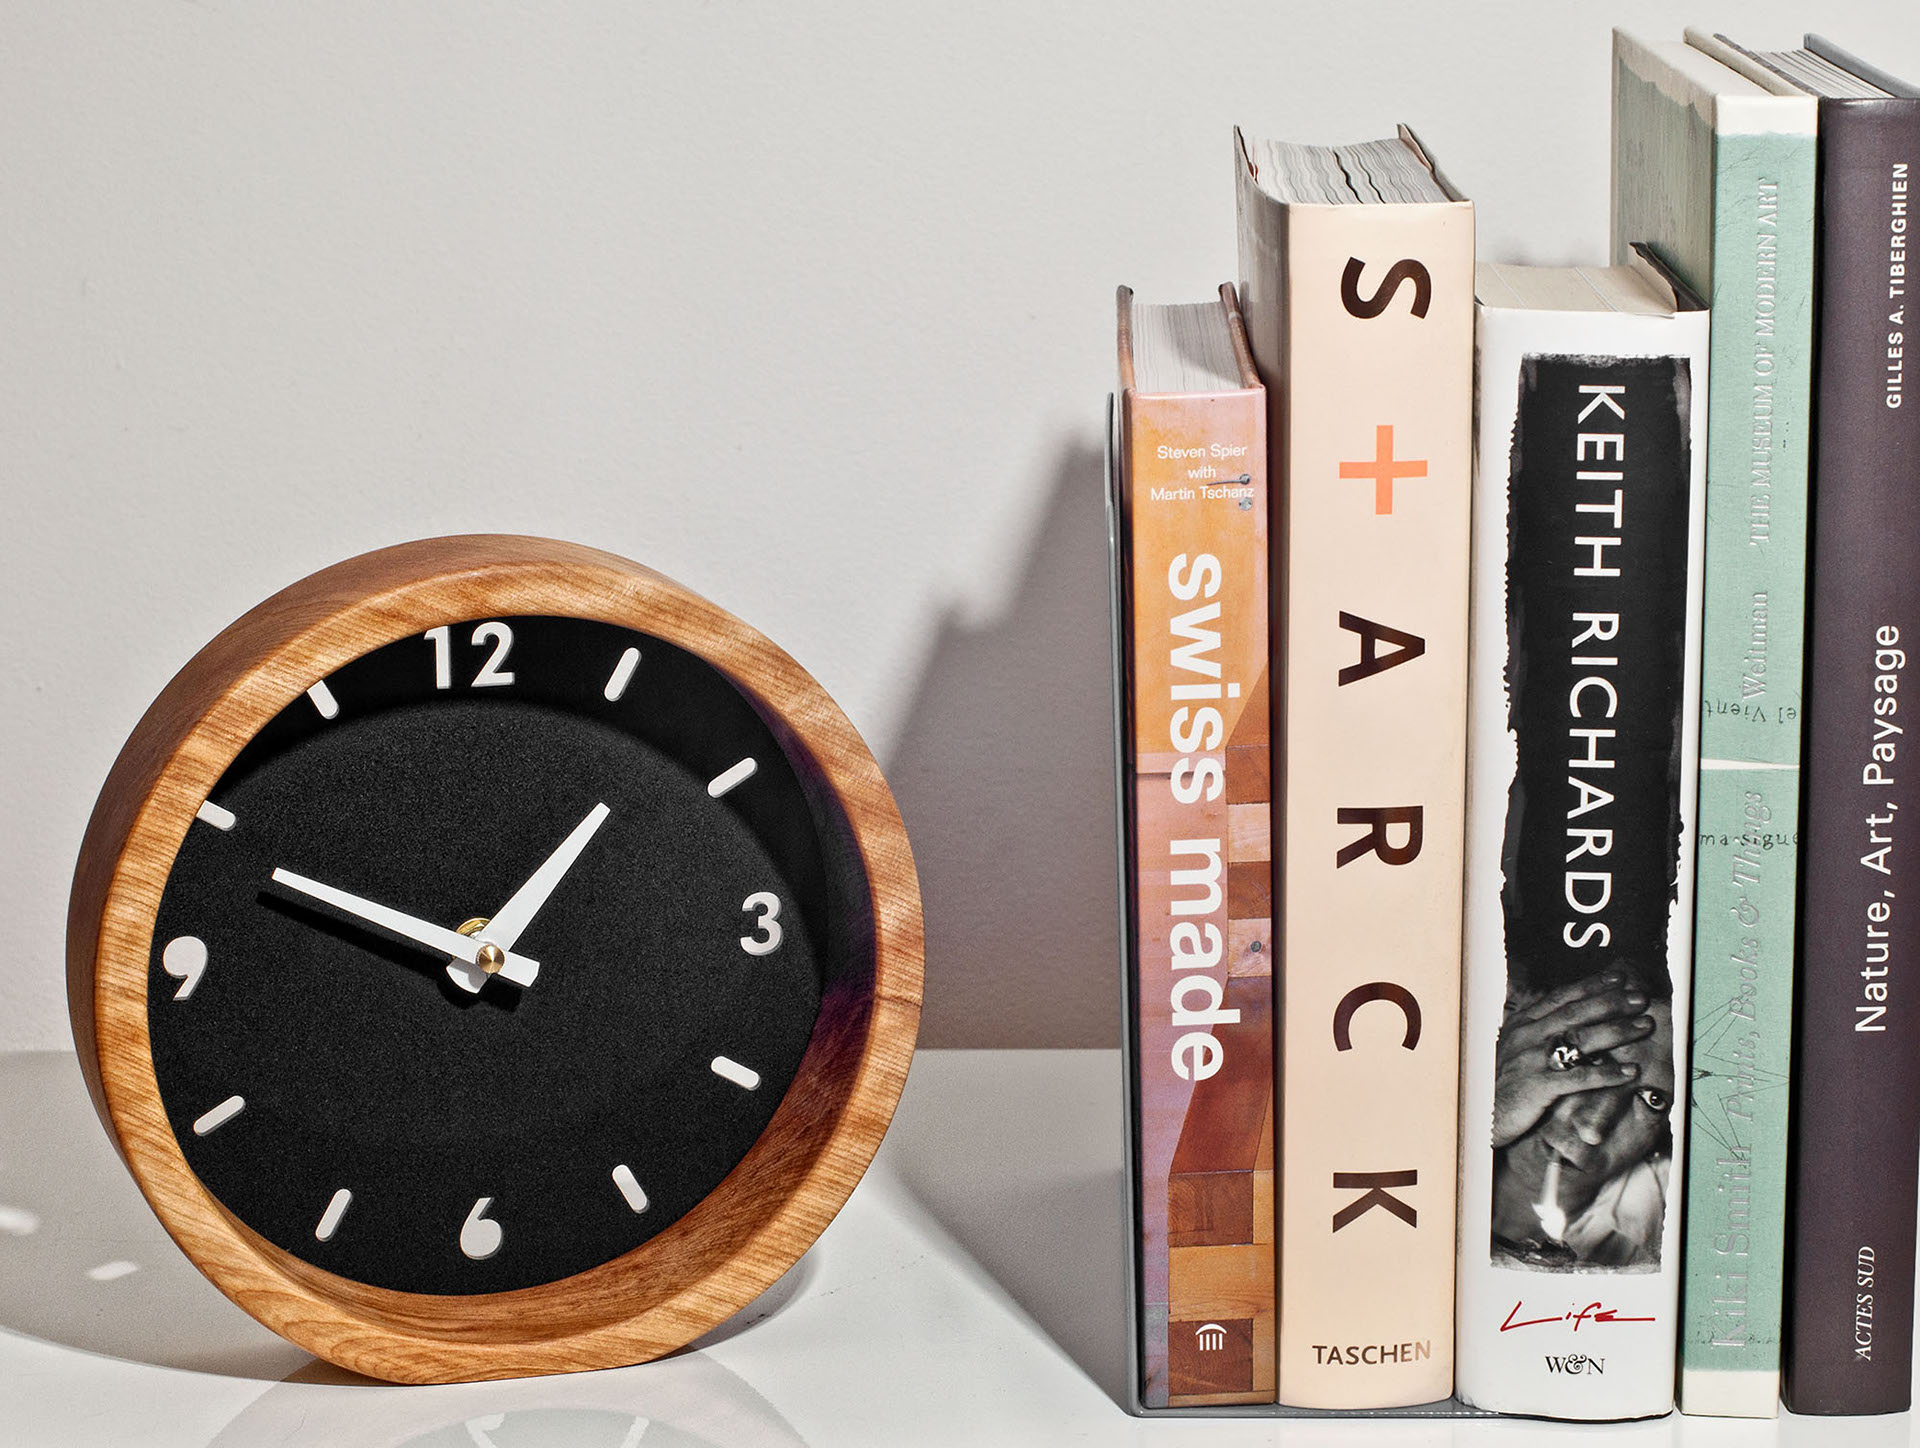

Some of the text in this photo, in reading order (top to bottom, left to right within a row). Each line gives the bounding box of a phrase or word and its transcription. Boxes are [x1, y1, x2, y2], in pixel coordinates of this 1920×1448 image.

[1887, 163, 1908, 409] GILLES A. TIBERGHIEN
[1750, 178, 1779, 545] THE MUSEUM OF MODERN ART
[1150, 484, 1255, 501] Martin Tschanz
[1156, 443, 1248, 461] Steven Spier
[1187, 464, 1217, 479] with
[424, 620, 516, 690] 12
[1563, 385, 1626, 948] KEITH RICHARDS
[1742, 591, 1769, 701] Weitman
[1167, 552, 1241, 1082] swiss made
[1732, 791, 1773, 888] Things
[1854, 625, 1906, 1032] Nature, Art, Paysage
[739, 891, 783, 956] 3
[161, 935, 210, 1001] 9
[1728, 936, 1759, 1021] Books
[1725, 1031, 1760, 1123] Prints,
[459, 1196, 503, 1260] 6
[1713, 1145, 1753, 1256] Smith
[1499, 1300, 1657, 1332] Life
[1711, 1272, 1749, 1350] Kiki
[1854, 1245, 1876, 1361] ACTES SUD
[1311, 1339, 1432, 1366] TASCHEN
[1544, 1353, 1607, 1376] W&N
